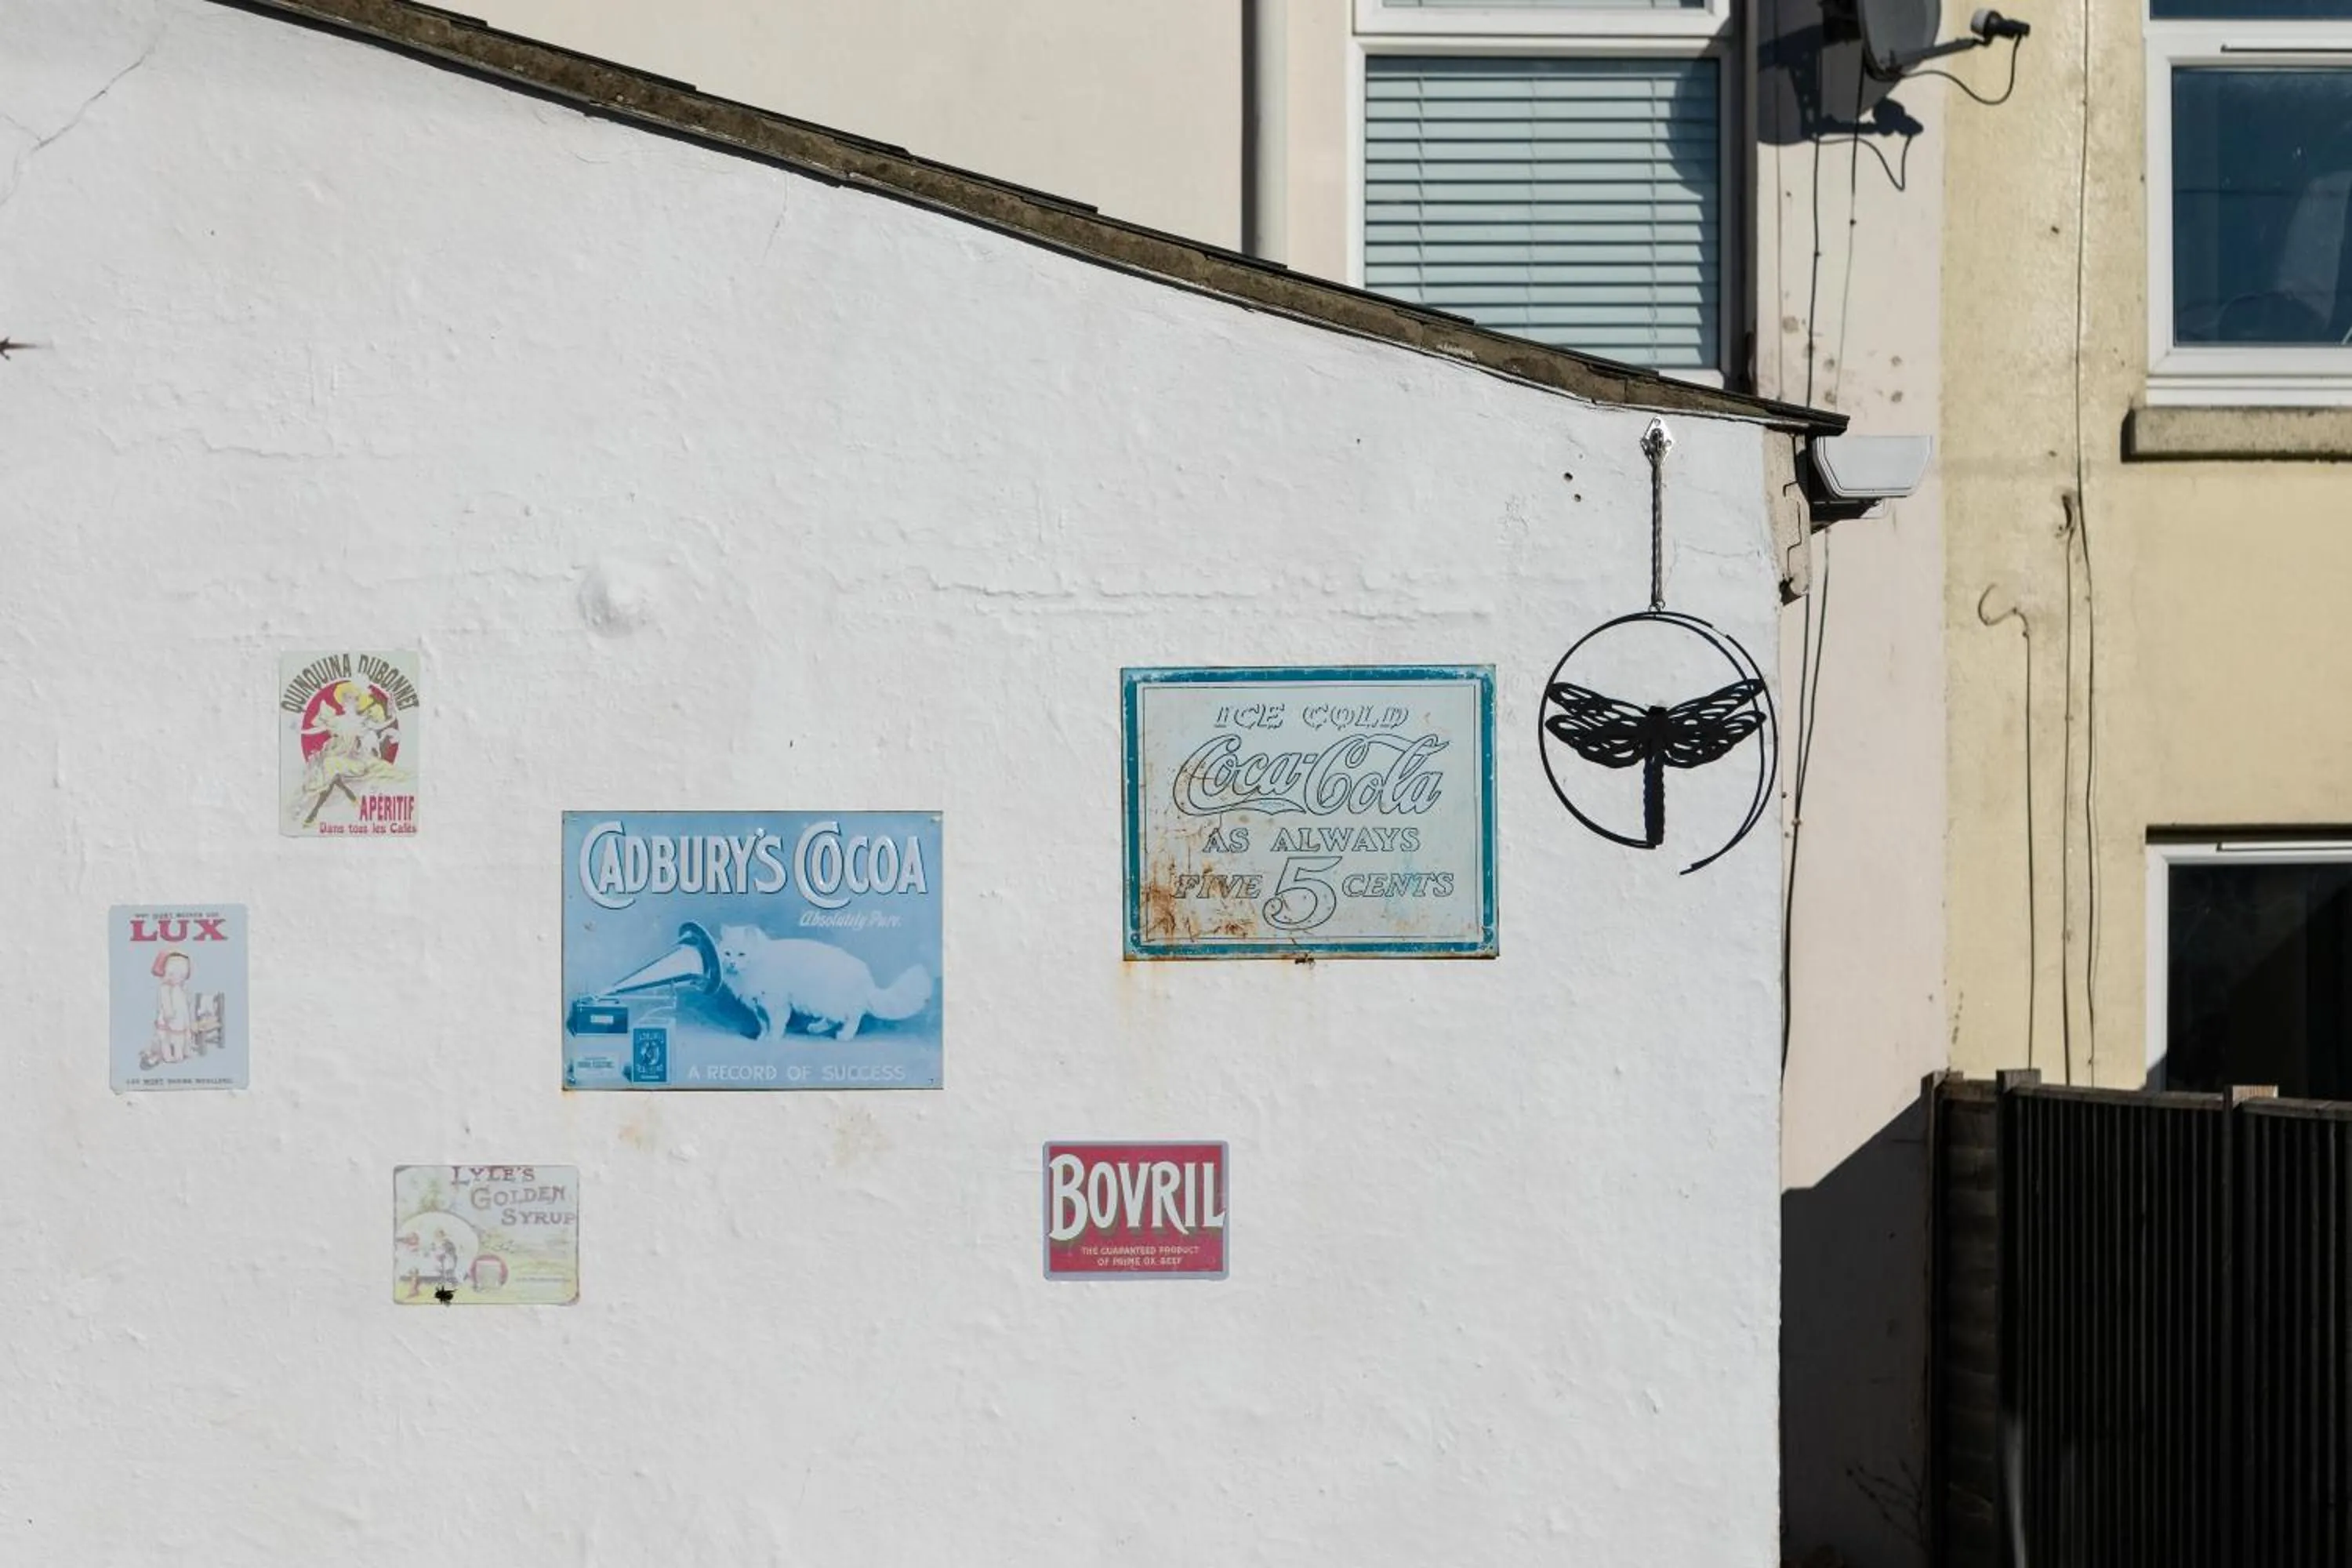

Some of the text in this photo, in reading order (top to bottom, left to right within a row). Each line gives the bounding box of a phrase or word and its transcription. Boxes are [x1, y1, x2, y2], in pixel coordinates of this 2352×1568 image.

[280, 653, 420, 714] QUINQUINA DUBONNET
[1214, 703, 1409, 729] ICE COLD
[1174, 733, 1450, 816] Coca-Cola
[1202, 827, 1421, 854] AS ALWAYS
[579, 820, 929, 909] CADBURY'S COCOA
[1174, 855, 1456, 931] FIVE 5 CENTS
[129, 918, 229, 942] LUX
[688, 1065, 907, 1082] A RECORD OF SUCCESS
[470, 1185, 566, 1210] GOLDEN
[1049, 1153, 1226, 1241] BOVRIL
[501, 1207, 576, 1227] SYRUP
[1081, 1245, 1201, 1255] THE GUARANTEED PRODUCT
[1097, 1256, 1182, 1267] OF PRIME OX BEEF
